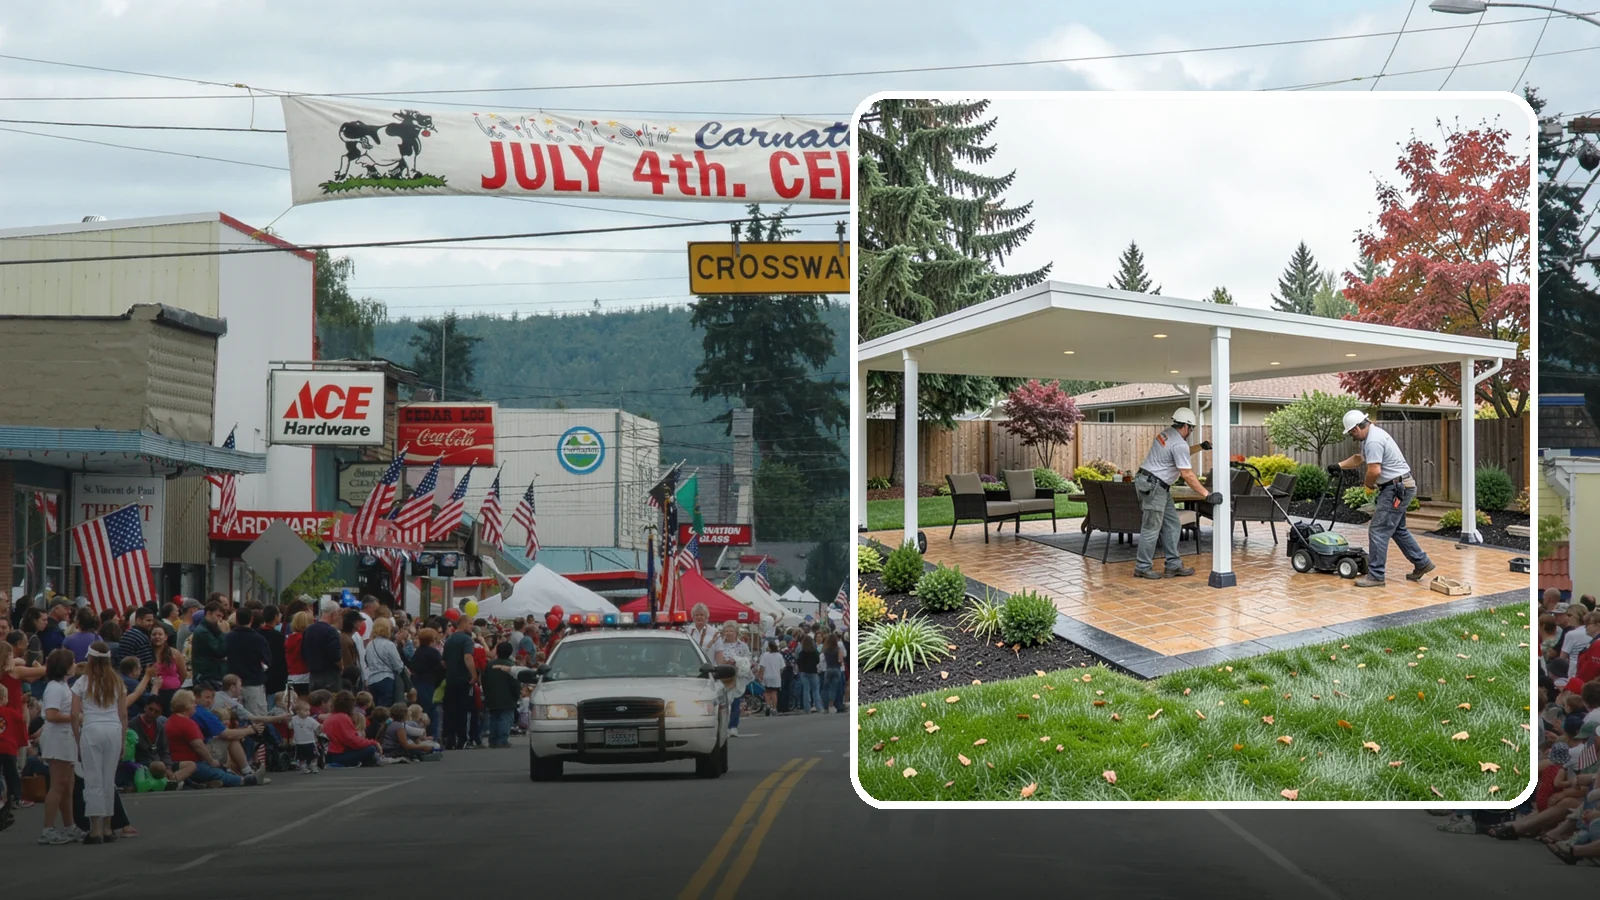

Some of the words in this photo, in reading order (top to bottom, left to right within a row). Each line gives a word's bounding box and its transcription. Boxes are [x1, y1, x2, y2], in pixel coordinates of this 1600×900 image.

[695, 121, 850, 149] Carnat
[481, 141, 605, 192] JULY
[632, 150, 746, 197] 4th.
[696, 254, 850, 280] CROSSWA
[283, 380, 373, 420] ACE
[405, 409, 452, 422] CEDAR
[284, 421, 370, 436] Hardware
[95, 485, 125, 495] Vincent
[126, 486, 136, 495] de
[138, 486, 155, 494] Paul
[688, 527, 741, 535] CRNATION
